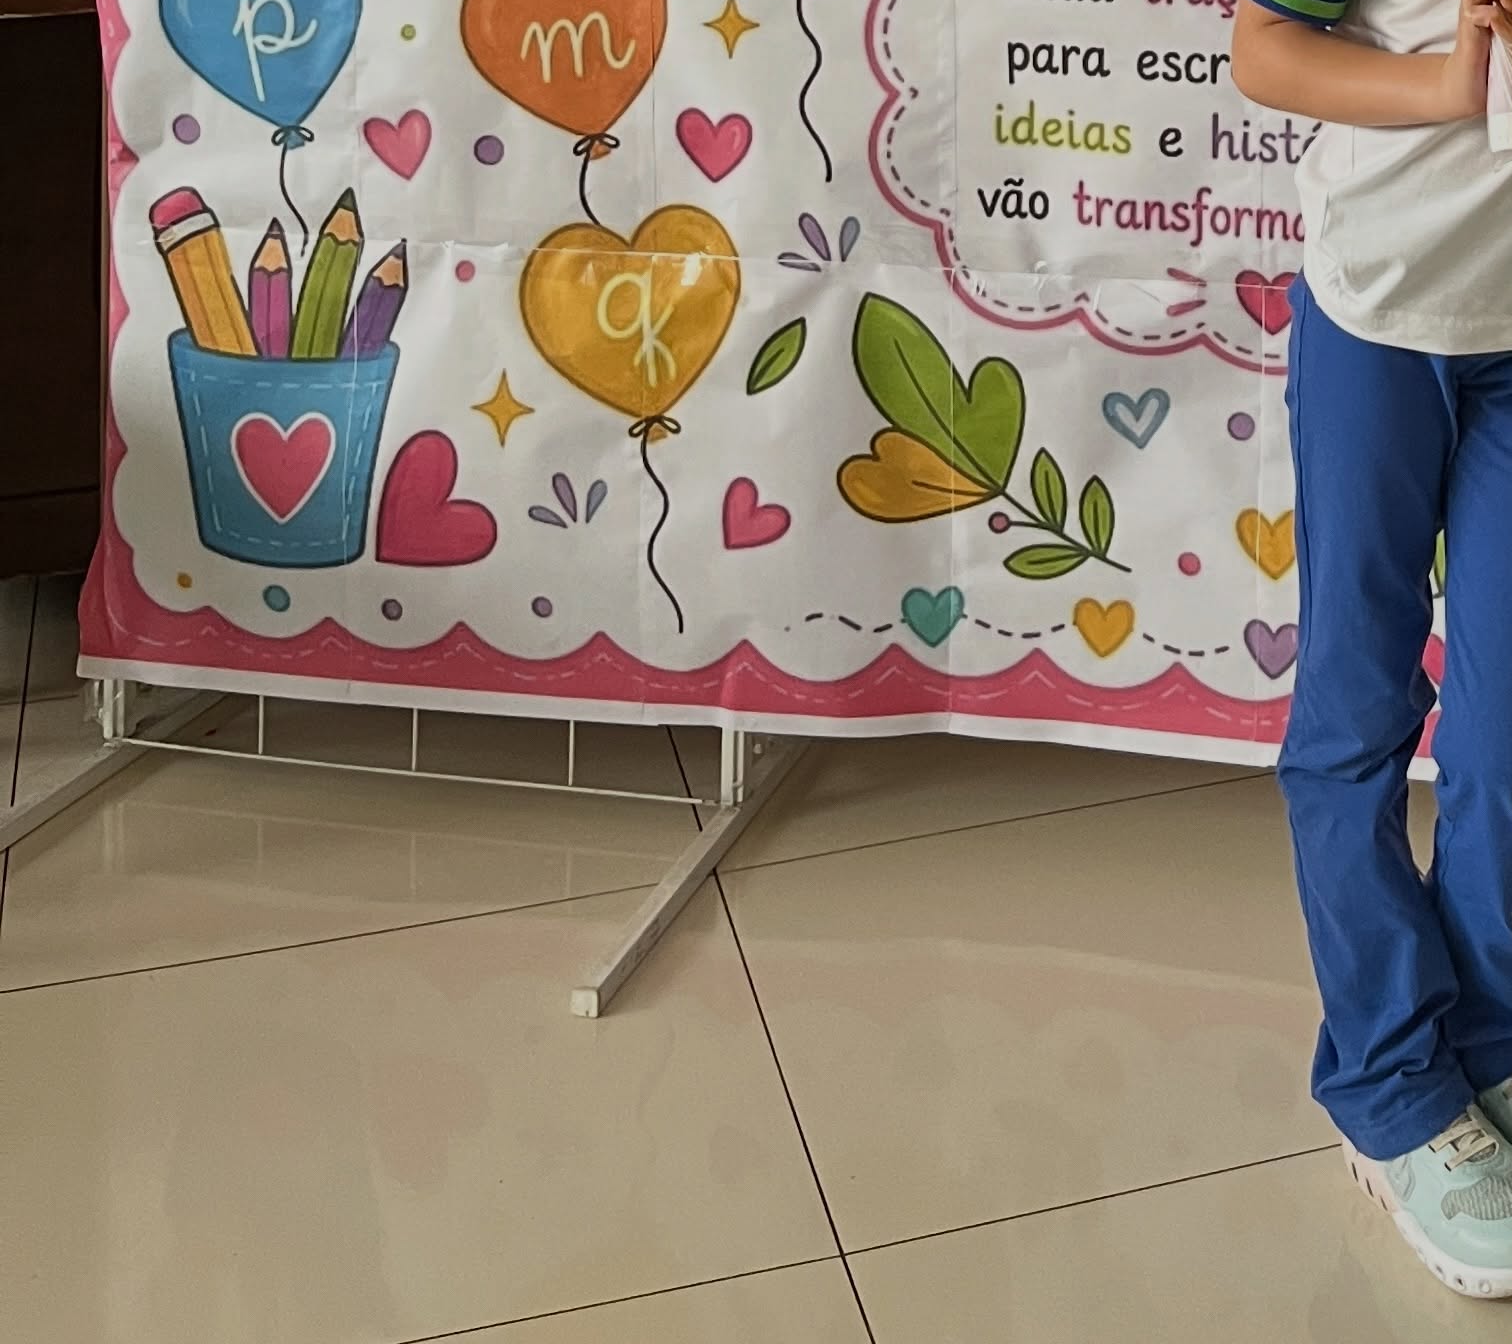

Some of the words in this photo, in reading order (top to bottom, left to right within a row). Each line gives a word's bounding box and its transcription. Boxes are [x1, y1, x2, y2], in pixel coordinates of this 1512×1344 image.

[520, 10, 635, 85] m
[1007, 40, 1111, 84] para
[994, 100, 1132, 155] ideias
[1158, 125, 1184, 159] e
[977, 177, 1050, 220] vão
